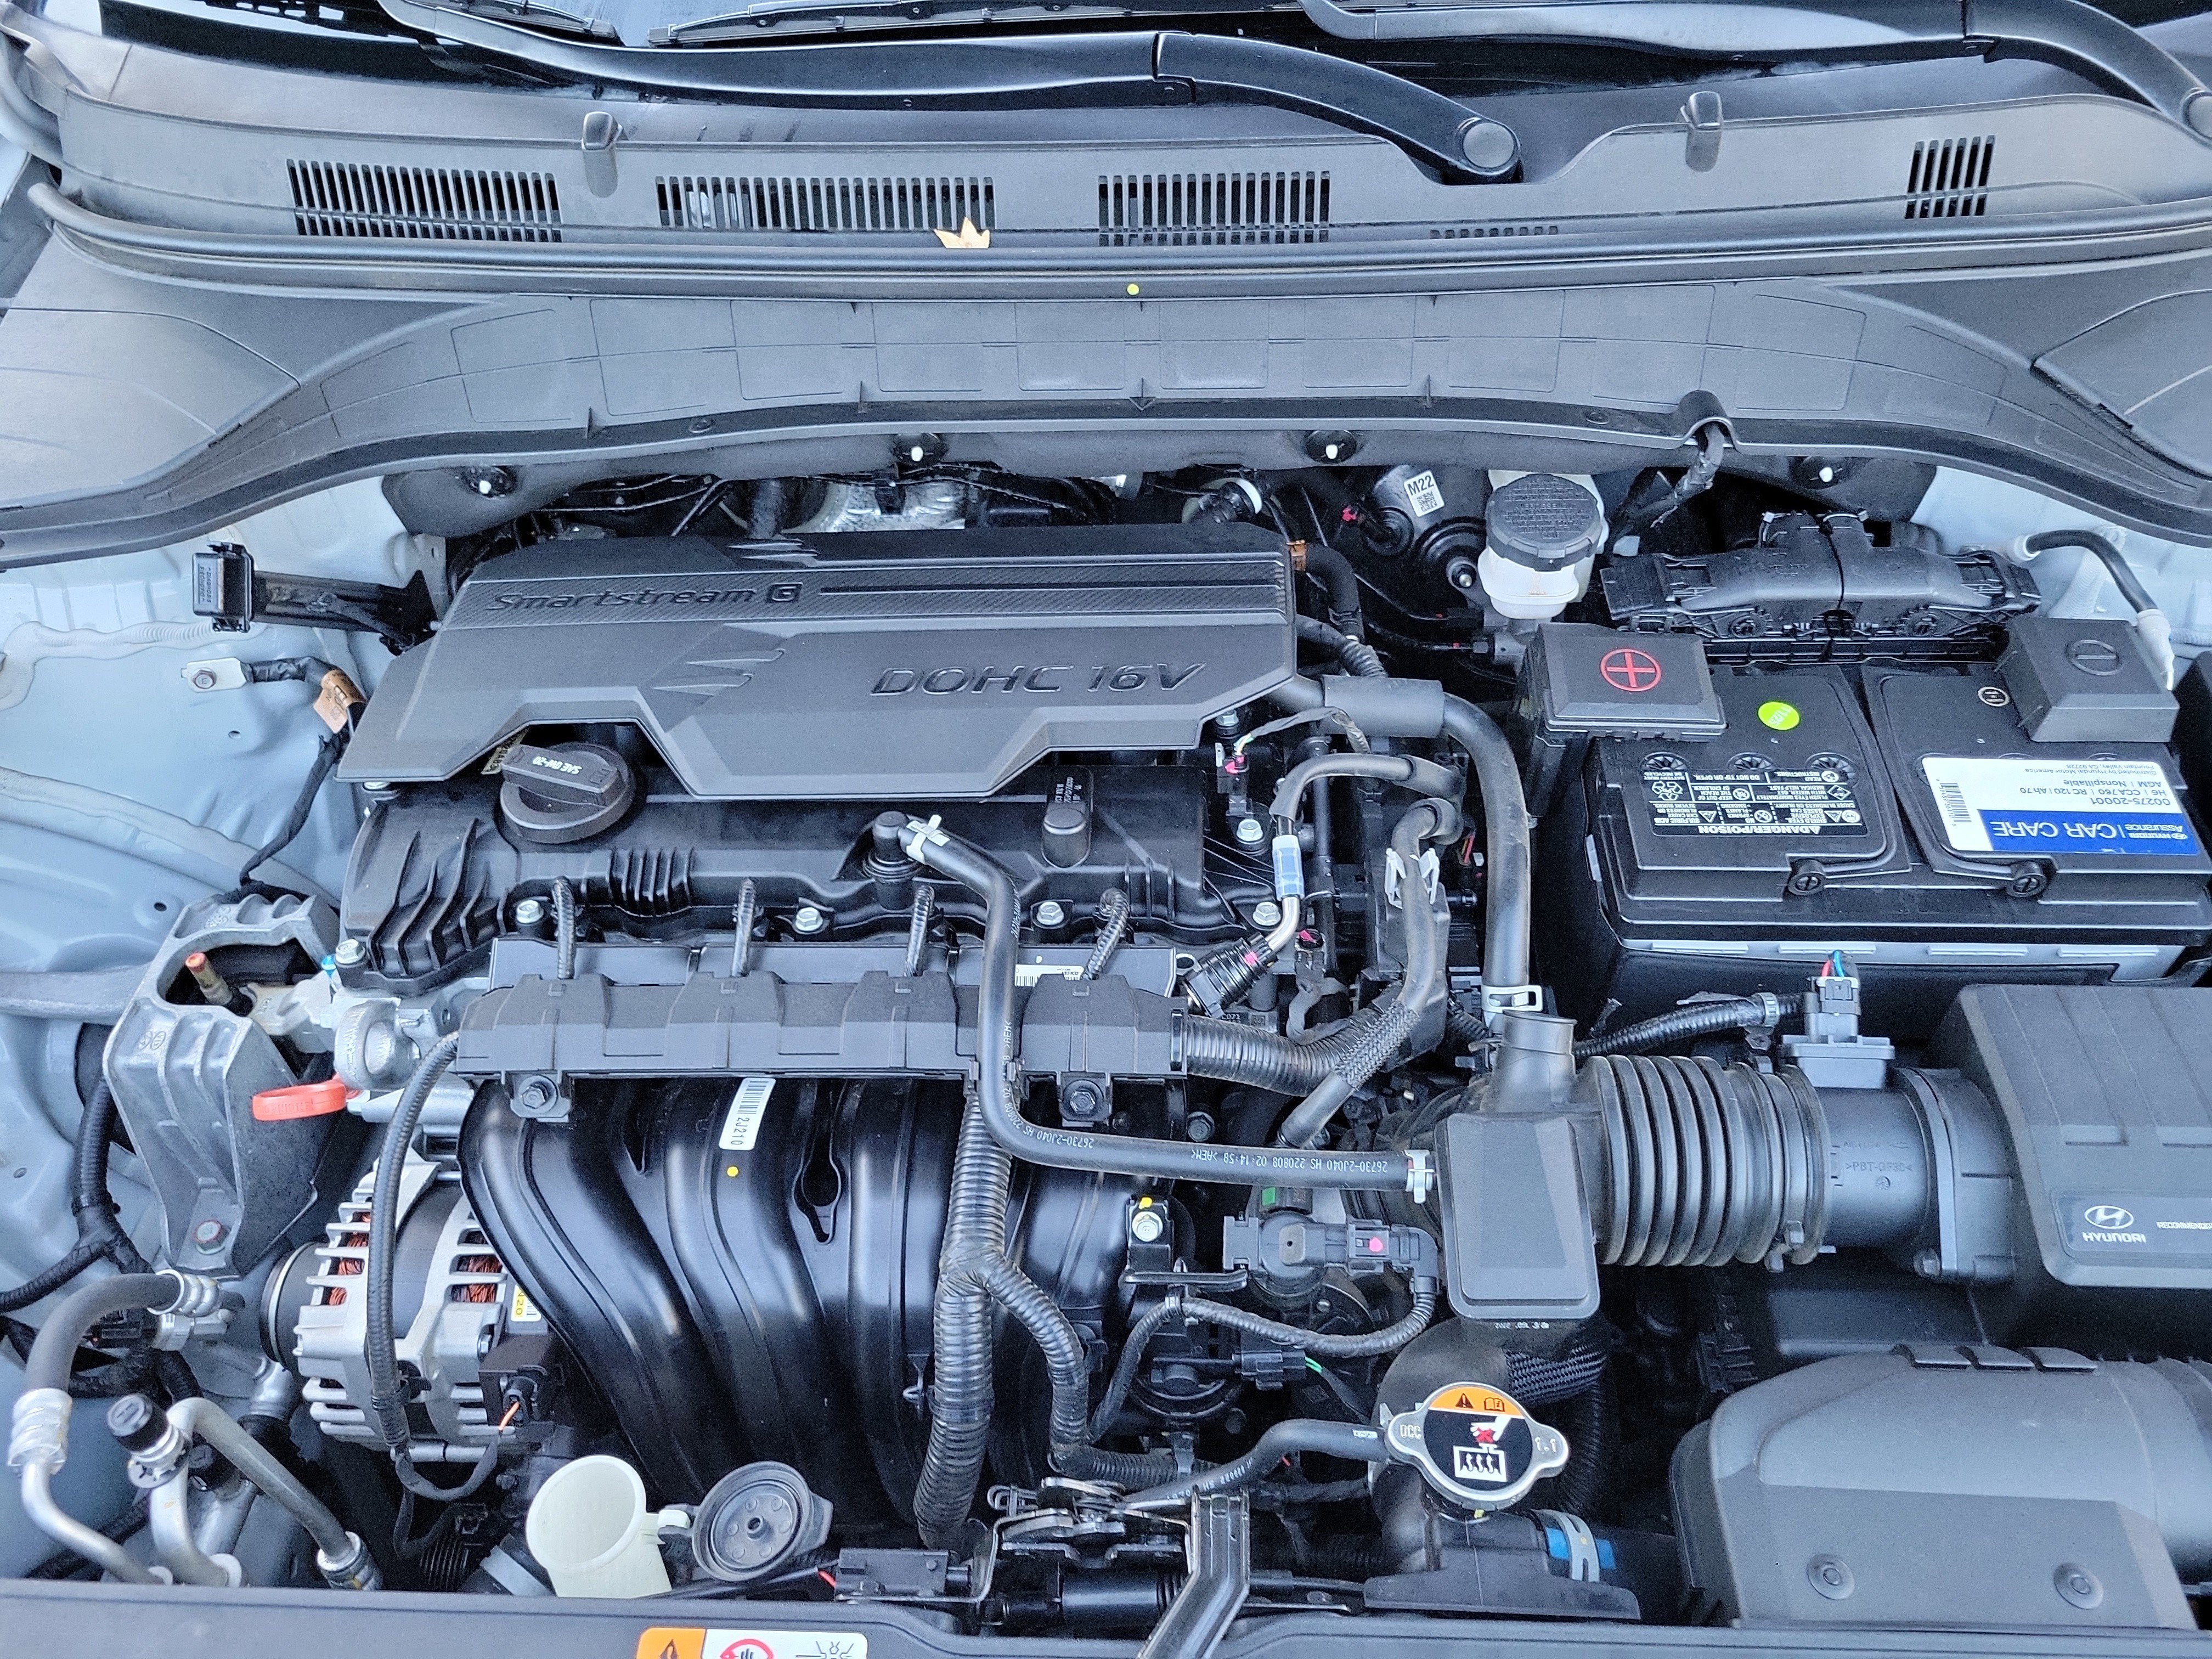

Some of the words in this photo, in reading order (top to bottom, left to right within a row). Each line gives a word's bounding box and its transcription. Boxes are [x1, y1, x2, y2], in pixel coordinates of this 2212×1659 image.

[1408, 476, 1434, 495] M22
[486, 588, 757, 611] Smartstream
[870, 665, 1074, 697] DOHC
[1087, 663, 1207, 692] 16V
[533, 757, 563, 770] 0W-20
[560, 763, 582, 774] SAE
[2090, 797, 2170, 805] 00275-20001
[1989, 821, 2058, 837] CARE
[2063, 823, 2117, 838] CAR
[2124, 824, 2183, 832] Assurance
[731, 1118, 750, 1145] 2J210
[1023, 1125, 1035, 1136] HS
[1036, 1130, 1094, 1148] 26730-2J040
[1191, 1149, 1218, 1161] >AEM<
[1273, 1157, 1306, 1169] 220808
[1310, 1158, 1322, 1170] HS
[1327, 1160, 1387, 1173] 26730-2J040
[2083, 1232, 2147, 1243] HYUNDAI
